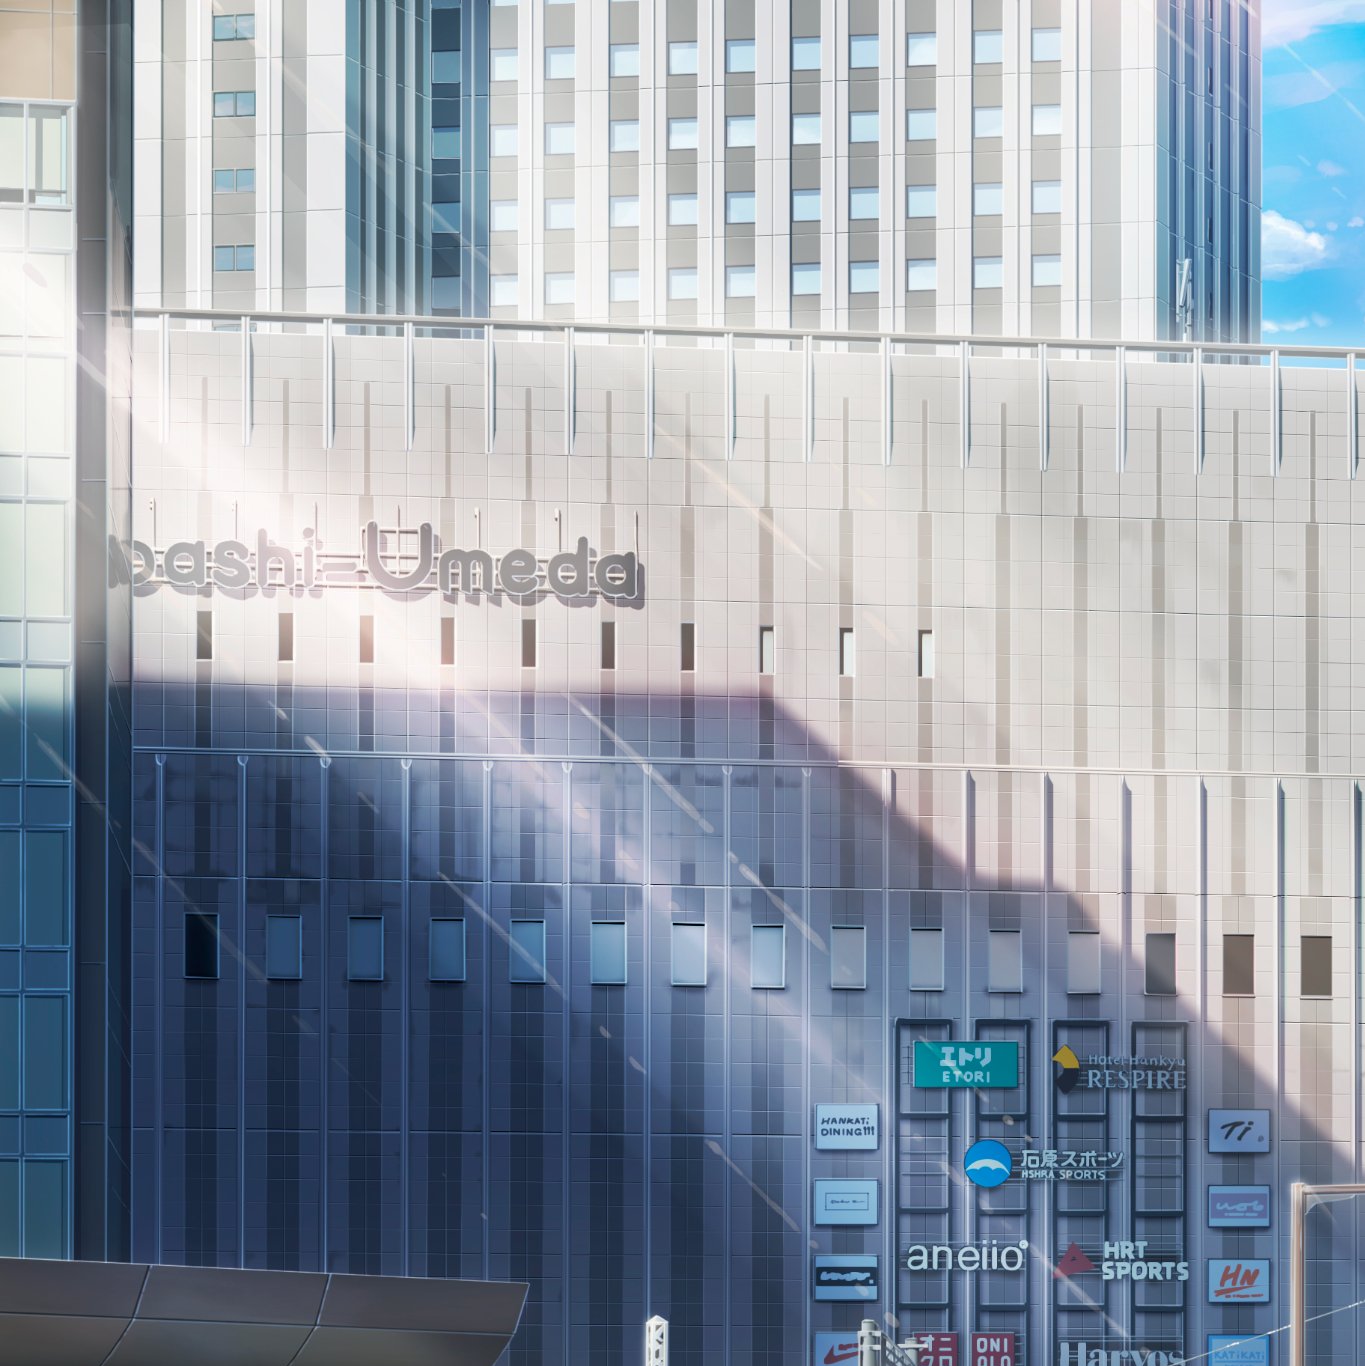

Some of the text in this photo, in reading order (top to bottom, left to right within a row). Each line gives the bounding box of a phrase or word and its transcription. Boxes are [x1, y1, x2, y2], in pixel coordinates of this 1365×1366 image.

[1088, 1054, 1187, 1070] Hotel Hankyu
[1087, 1069, 1187, 1090] RESPIRE
[1020, 1149, 1125, 1169] 石原スポーツ
[1058, 1169, 1106, 1180] SPORTS
[1103, 1240, 1149, 1260] HRT
[1101, 1261, 1189, 1281] SPORTS
